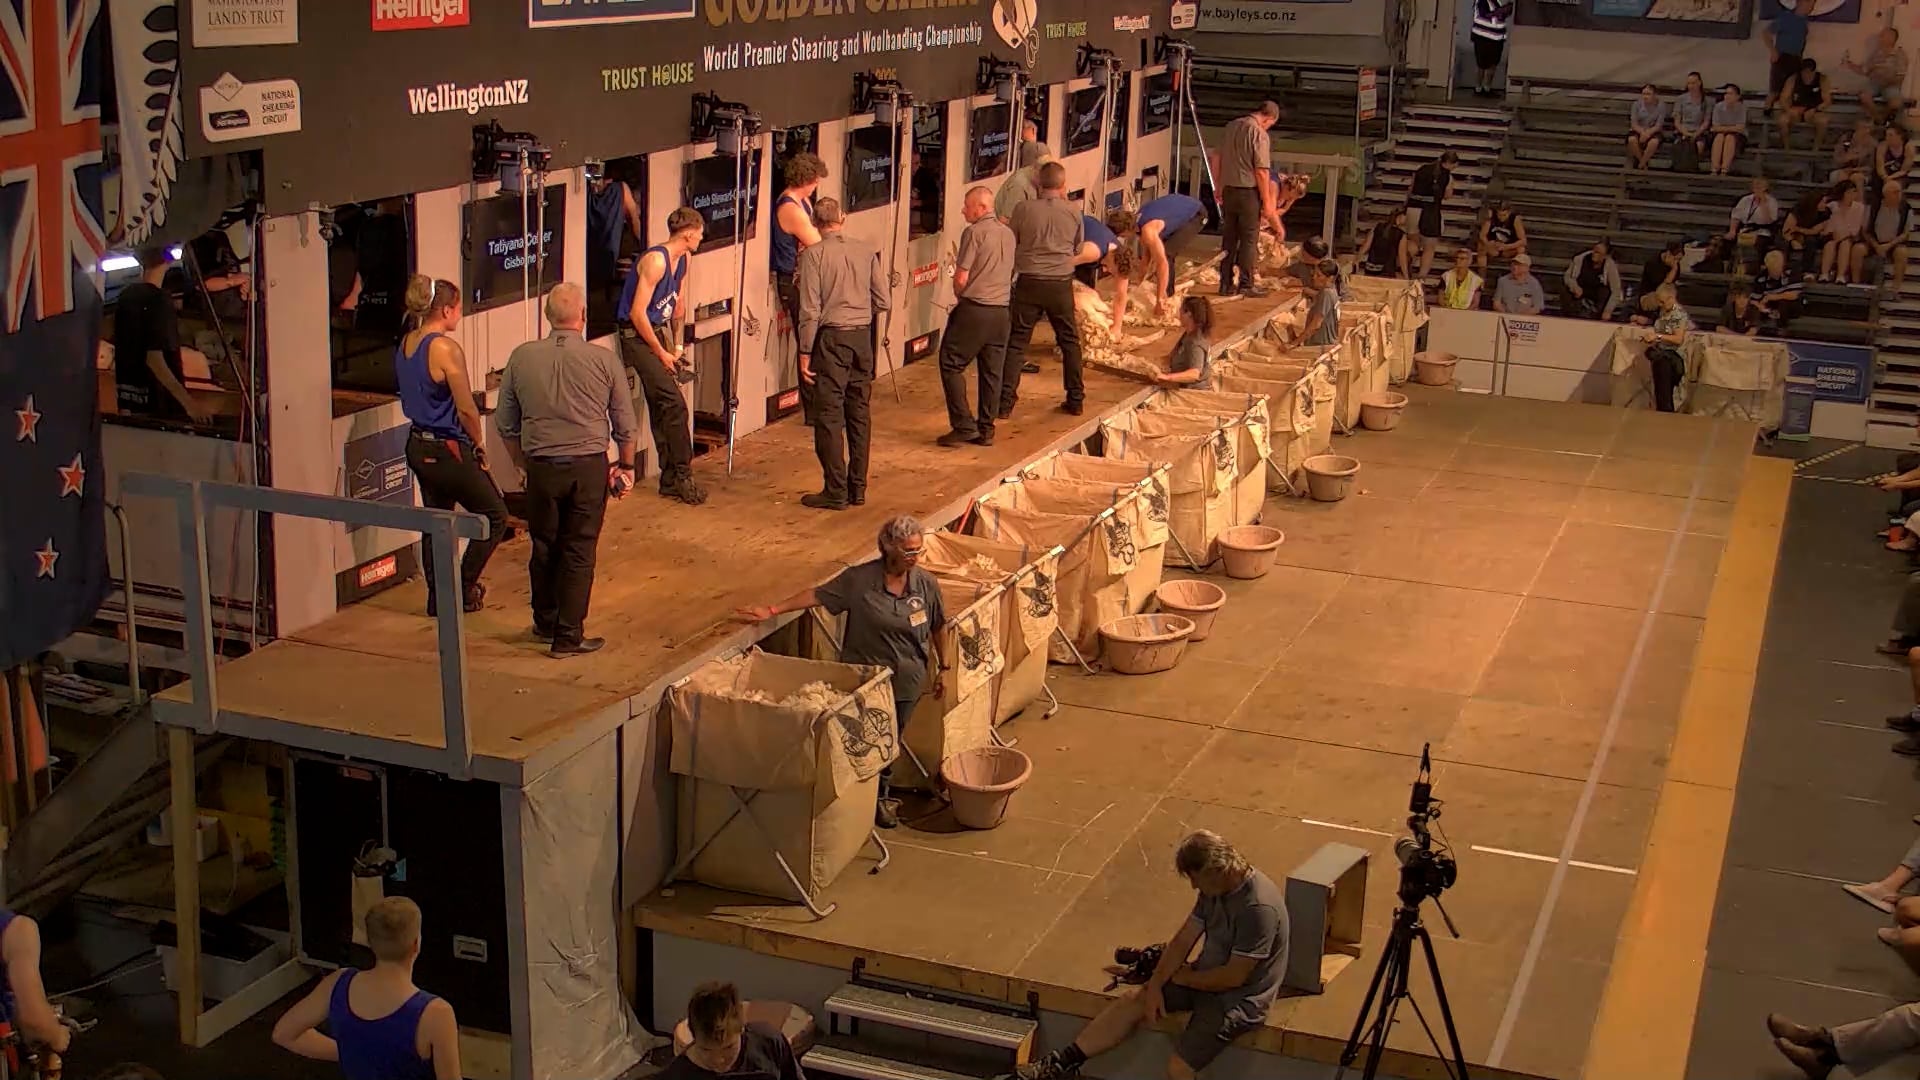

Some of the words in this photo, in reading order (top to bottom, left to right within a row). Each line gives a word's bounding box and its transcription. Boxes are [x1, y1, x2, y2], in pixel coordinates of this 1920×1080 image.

[208, 10, 248, 25] LANDS
[250, 9, 285, 24] TRUST
[703, 42, 739, 73] World
[744, 41, 788, 68] Premier
[791, 33, 839, 62] Shearing
[842, 31, 860, 56] and
[862, 27, 923, 53] Woolhandling
[925, 20, 982, 49] Championship
[602, 66, 647, 91] TRUST
[652, 62, 695, 86] HOUSE
[261, 89, 295, 101] NATIONAL
[408, 79, 529, 115] WellingtonNZ
[262, 113, 288, 125] CIRCUIT
[504, 253, 537, 270] Gisbone
[475, 288, 481, 304] 1
